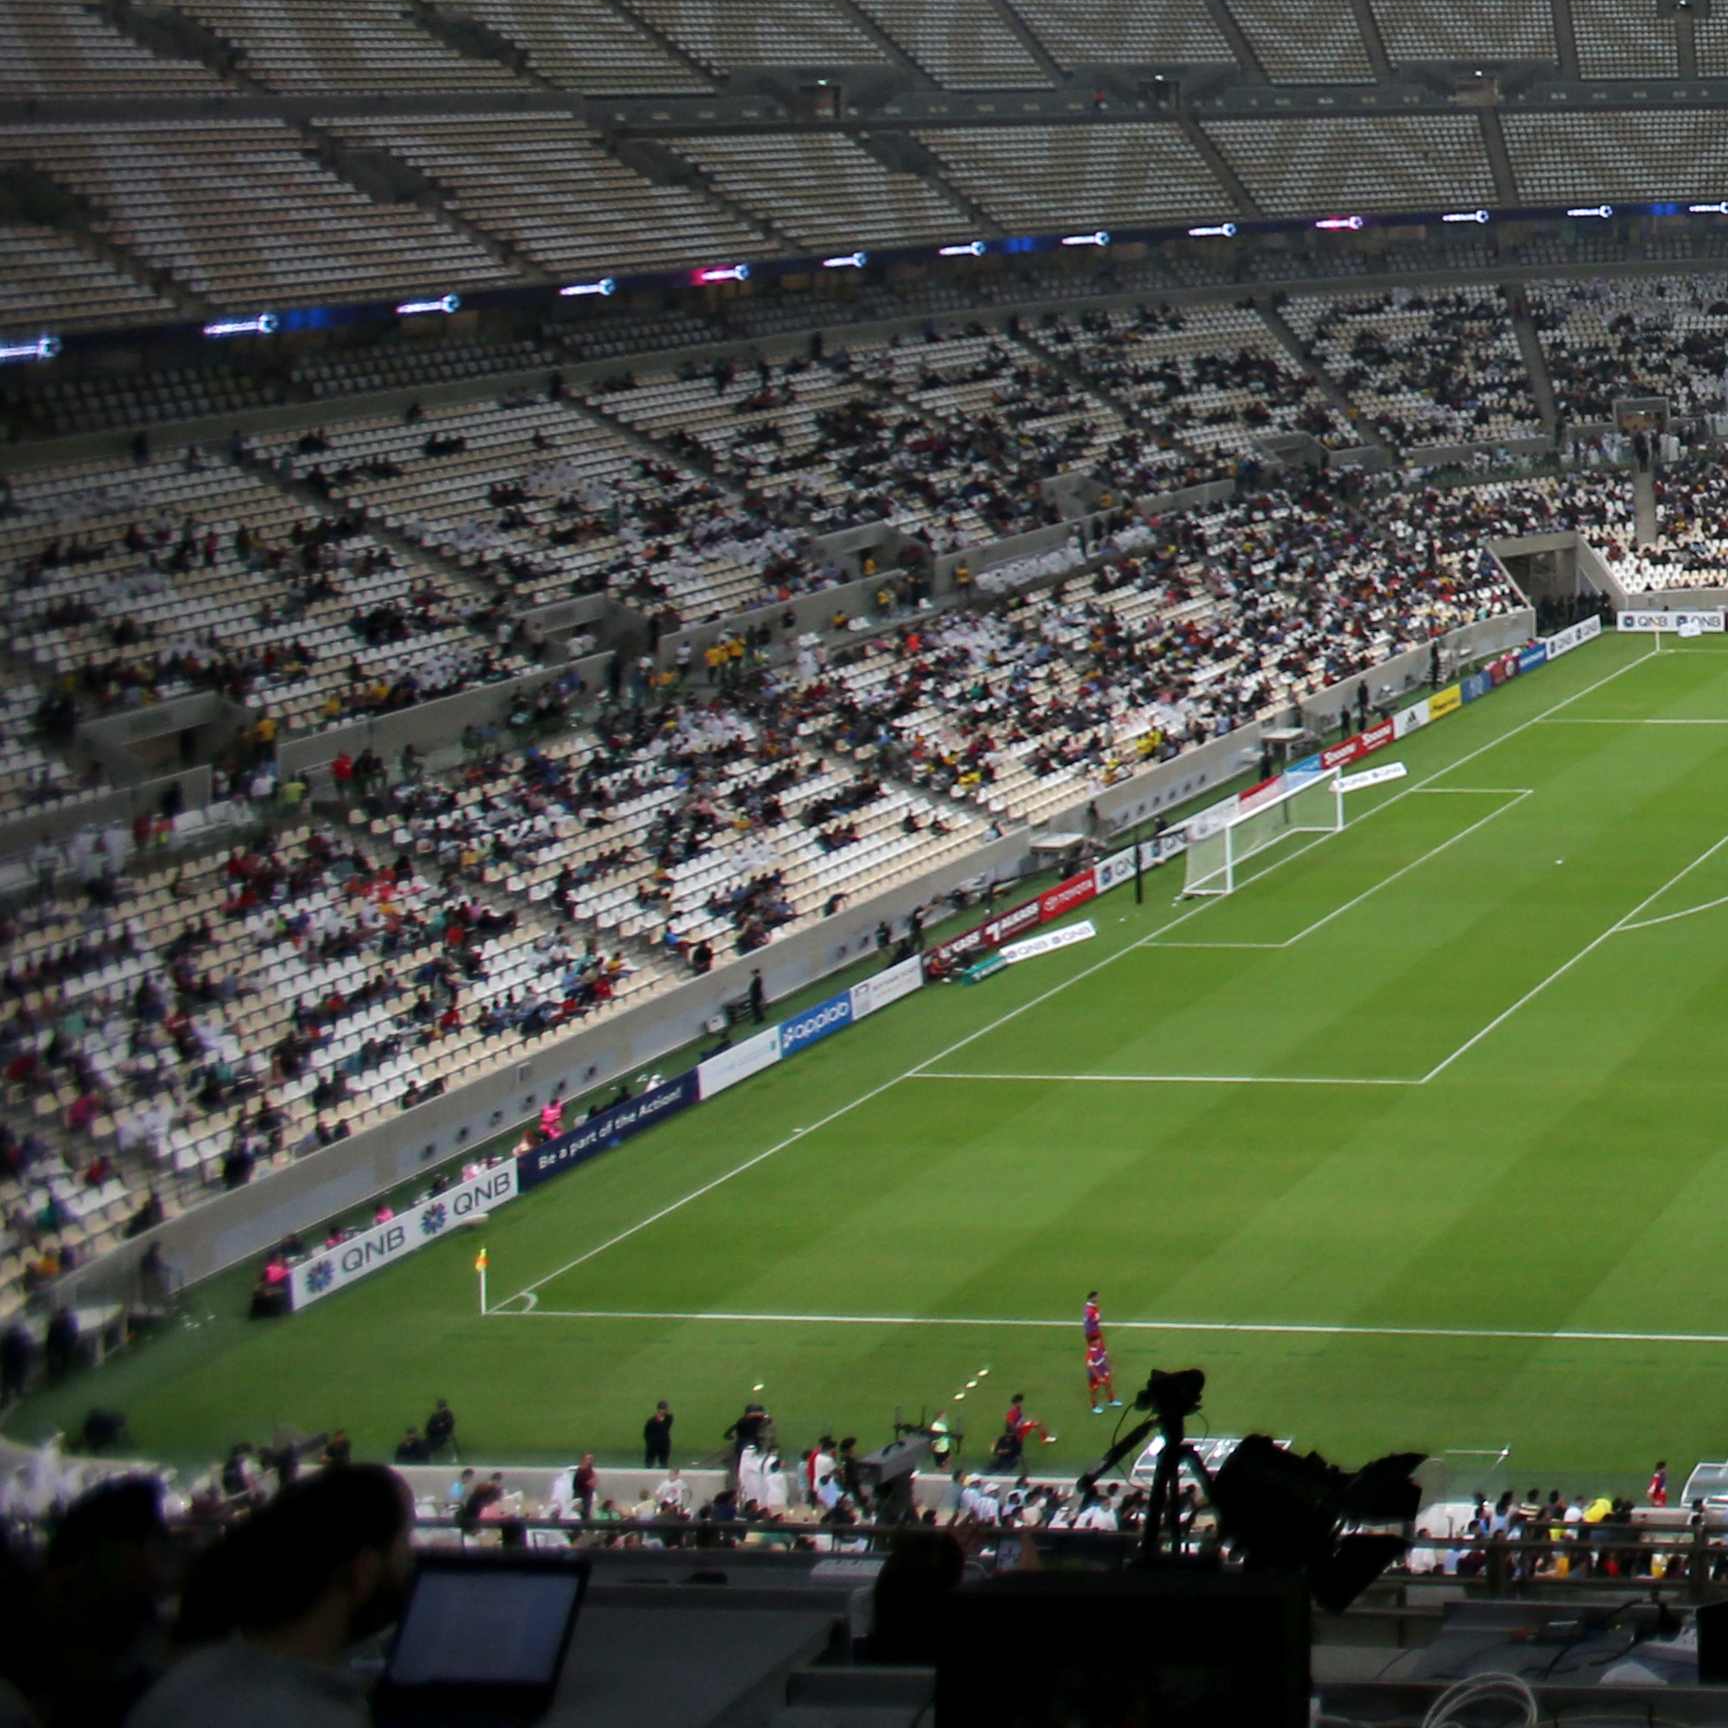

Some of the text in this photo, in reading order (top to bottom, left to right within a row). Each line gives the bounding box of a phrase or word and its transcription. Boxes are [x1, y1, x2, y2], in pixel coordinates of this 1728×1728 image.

[795, 1001, 850, 1039] applab
[538, 1152, 557, 1170] Be
[558, 1148, 567, 1159] a
[569, 1131, 598, 1157] part
[599, 1119, 613, 1138] of
[614, 1112, 636, 1130] the
[453, 1172, 511, 1216] QNB
[341, 1225, 406, 1272] QNB
